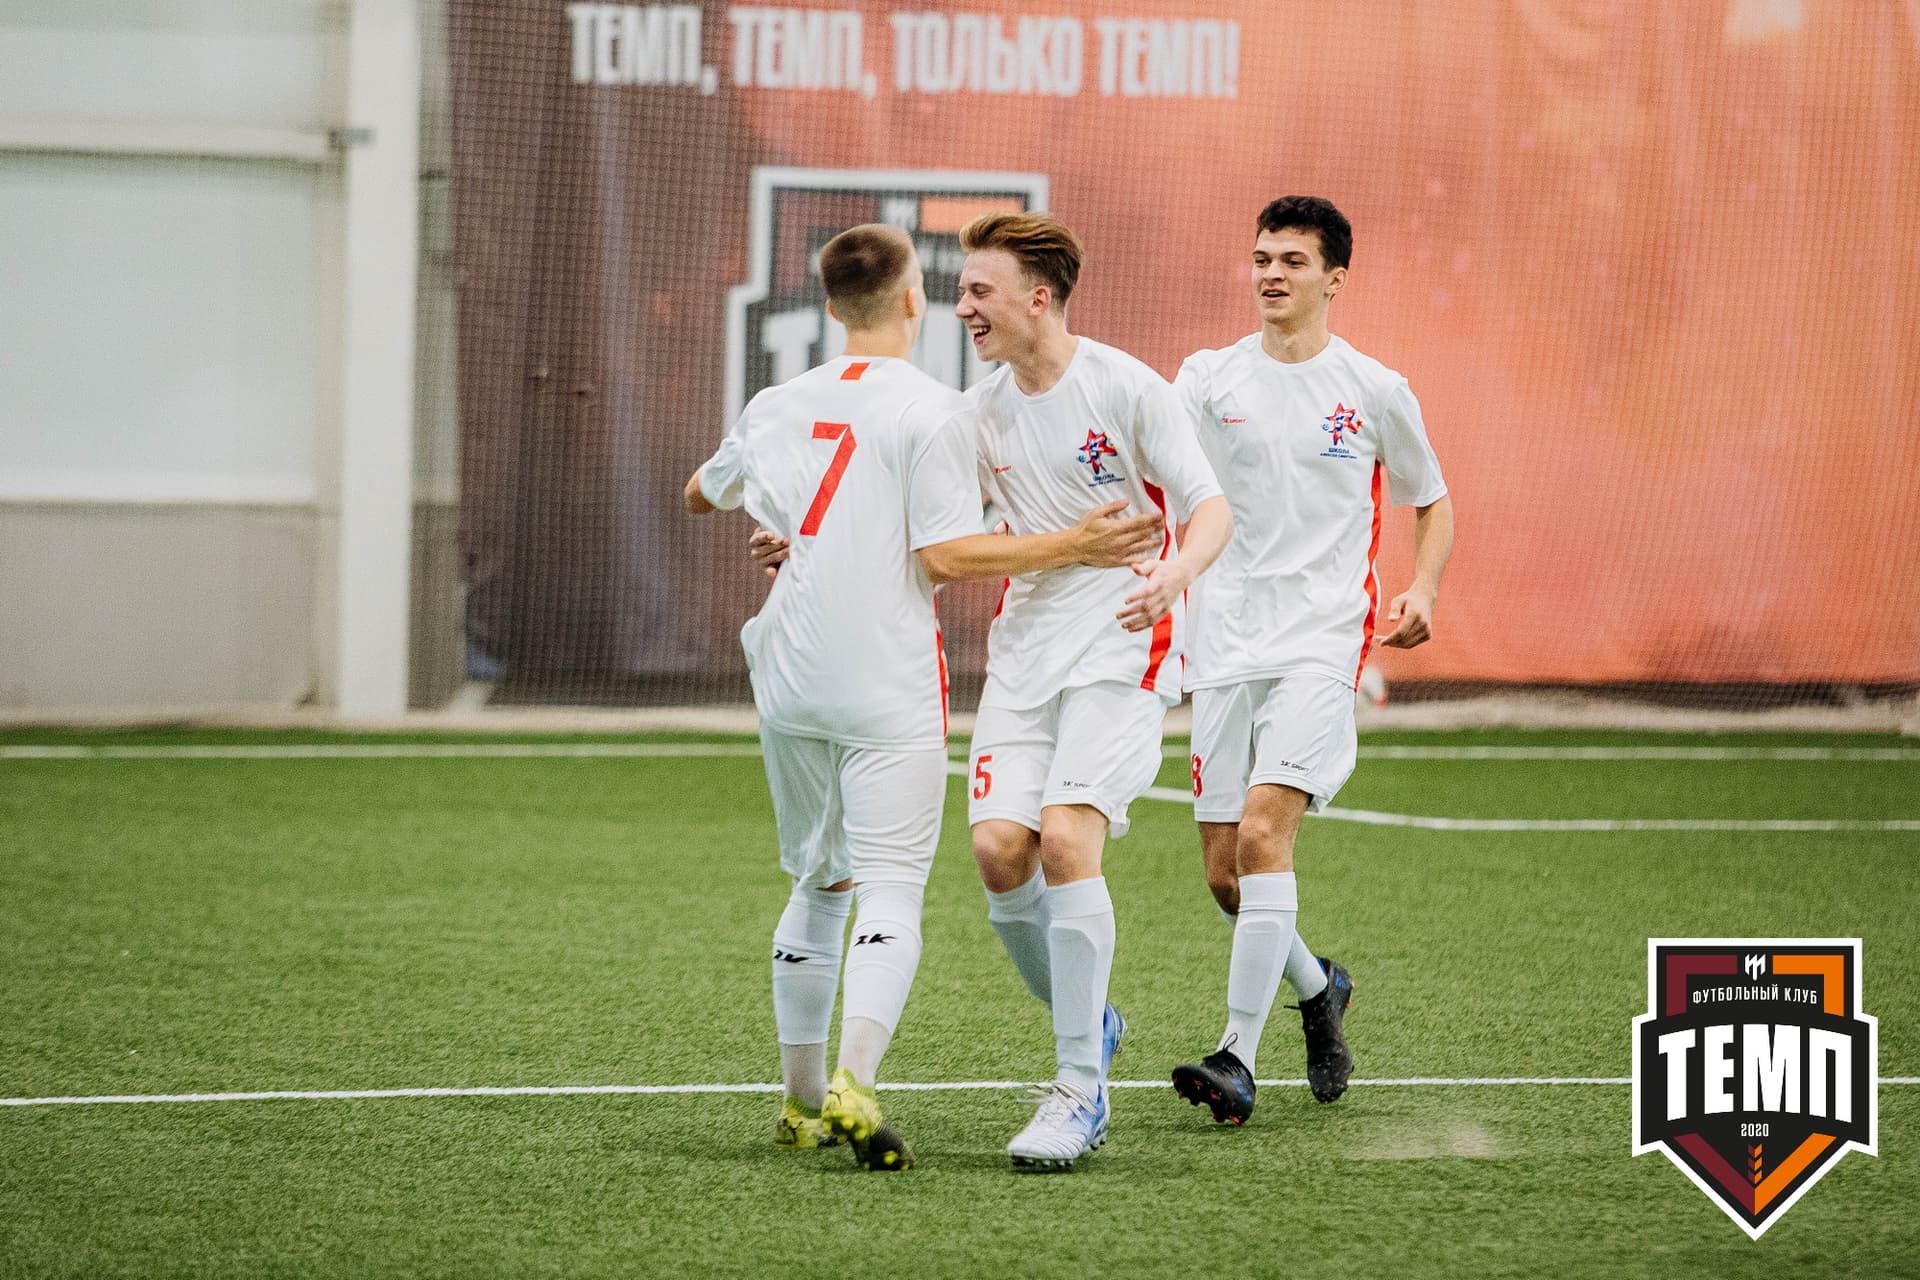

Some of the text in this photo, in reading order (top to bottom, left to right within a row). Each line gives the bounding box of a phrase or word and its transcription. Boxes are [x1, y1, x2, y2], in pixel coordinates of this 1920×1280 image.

[570, 4, 1240, 100] ТЕМП, ТЕМП, ТОЛЬКО ТЕМП!
[799, 421, 858, 537] 7
[973, 754, 993, 800] 5
